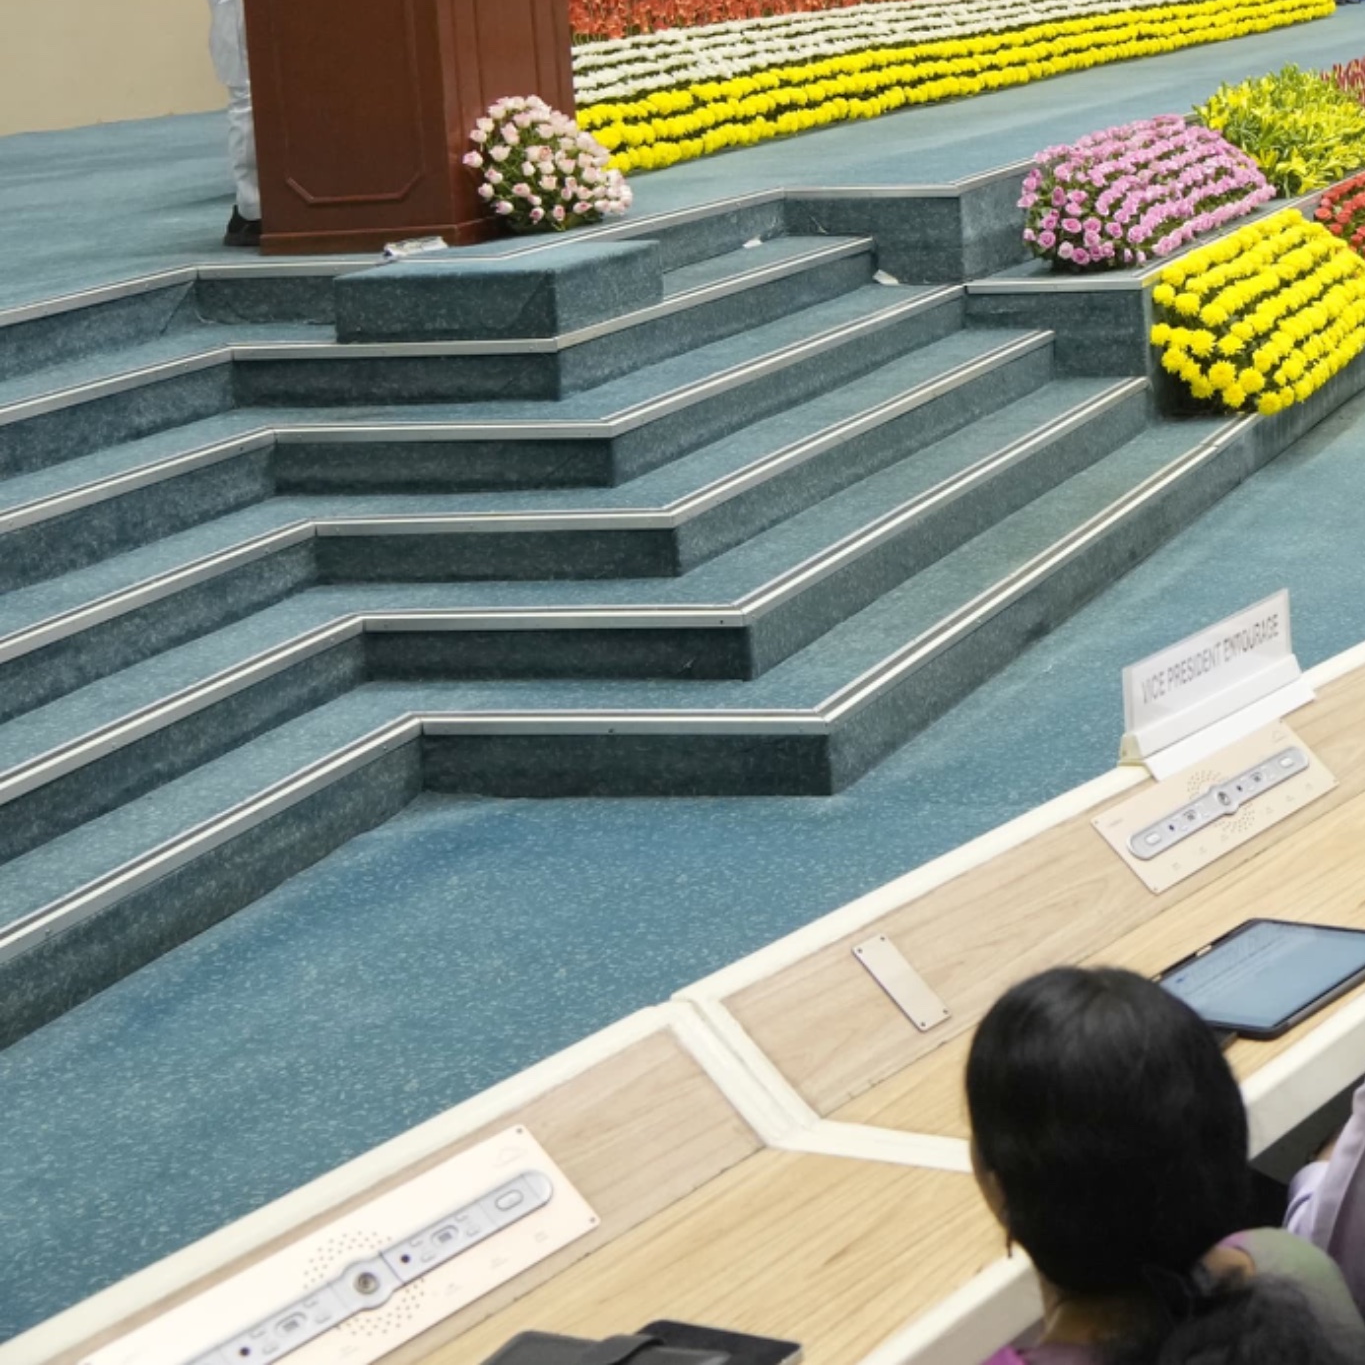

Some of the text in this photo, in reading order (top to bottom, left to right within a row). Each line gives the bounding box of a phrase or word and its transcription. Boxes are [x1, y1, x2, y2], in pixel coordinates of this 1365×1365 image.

[1141, 614, 1279, 704] VICE PRESIDENT ENTOURAGE
